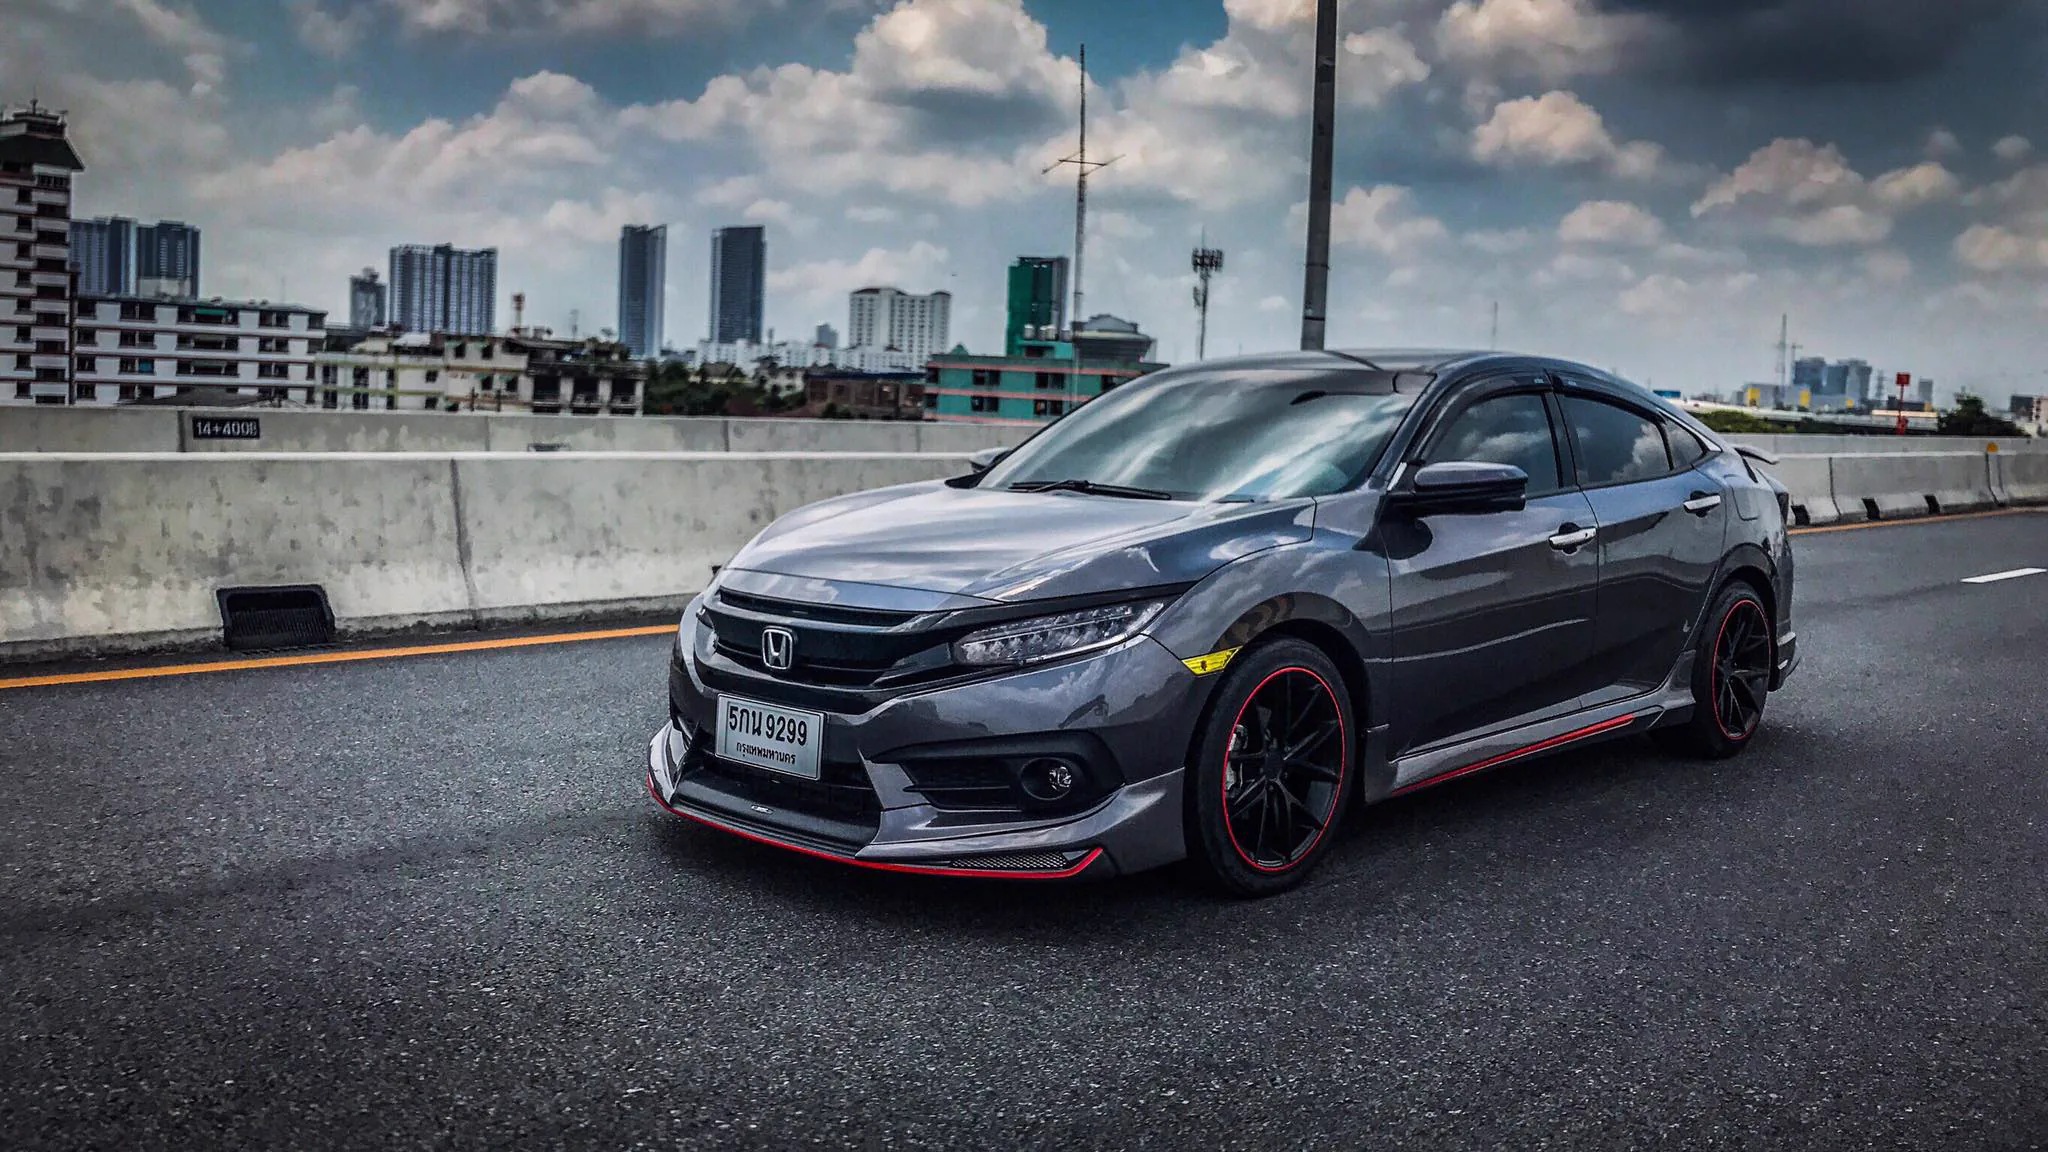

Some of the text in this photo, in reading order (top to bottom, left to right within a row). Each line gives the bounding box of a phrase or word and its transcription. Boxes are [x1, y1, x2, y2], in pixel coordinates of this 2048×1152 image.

[766, 714, 807, 746] 9299
[736, 742, 796, 764] กรุงเทพมหานคร
